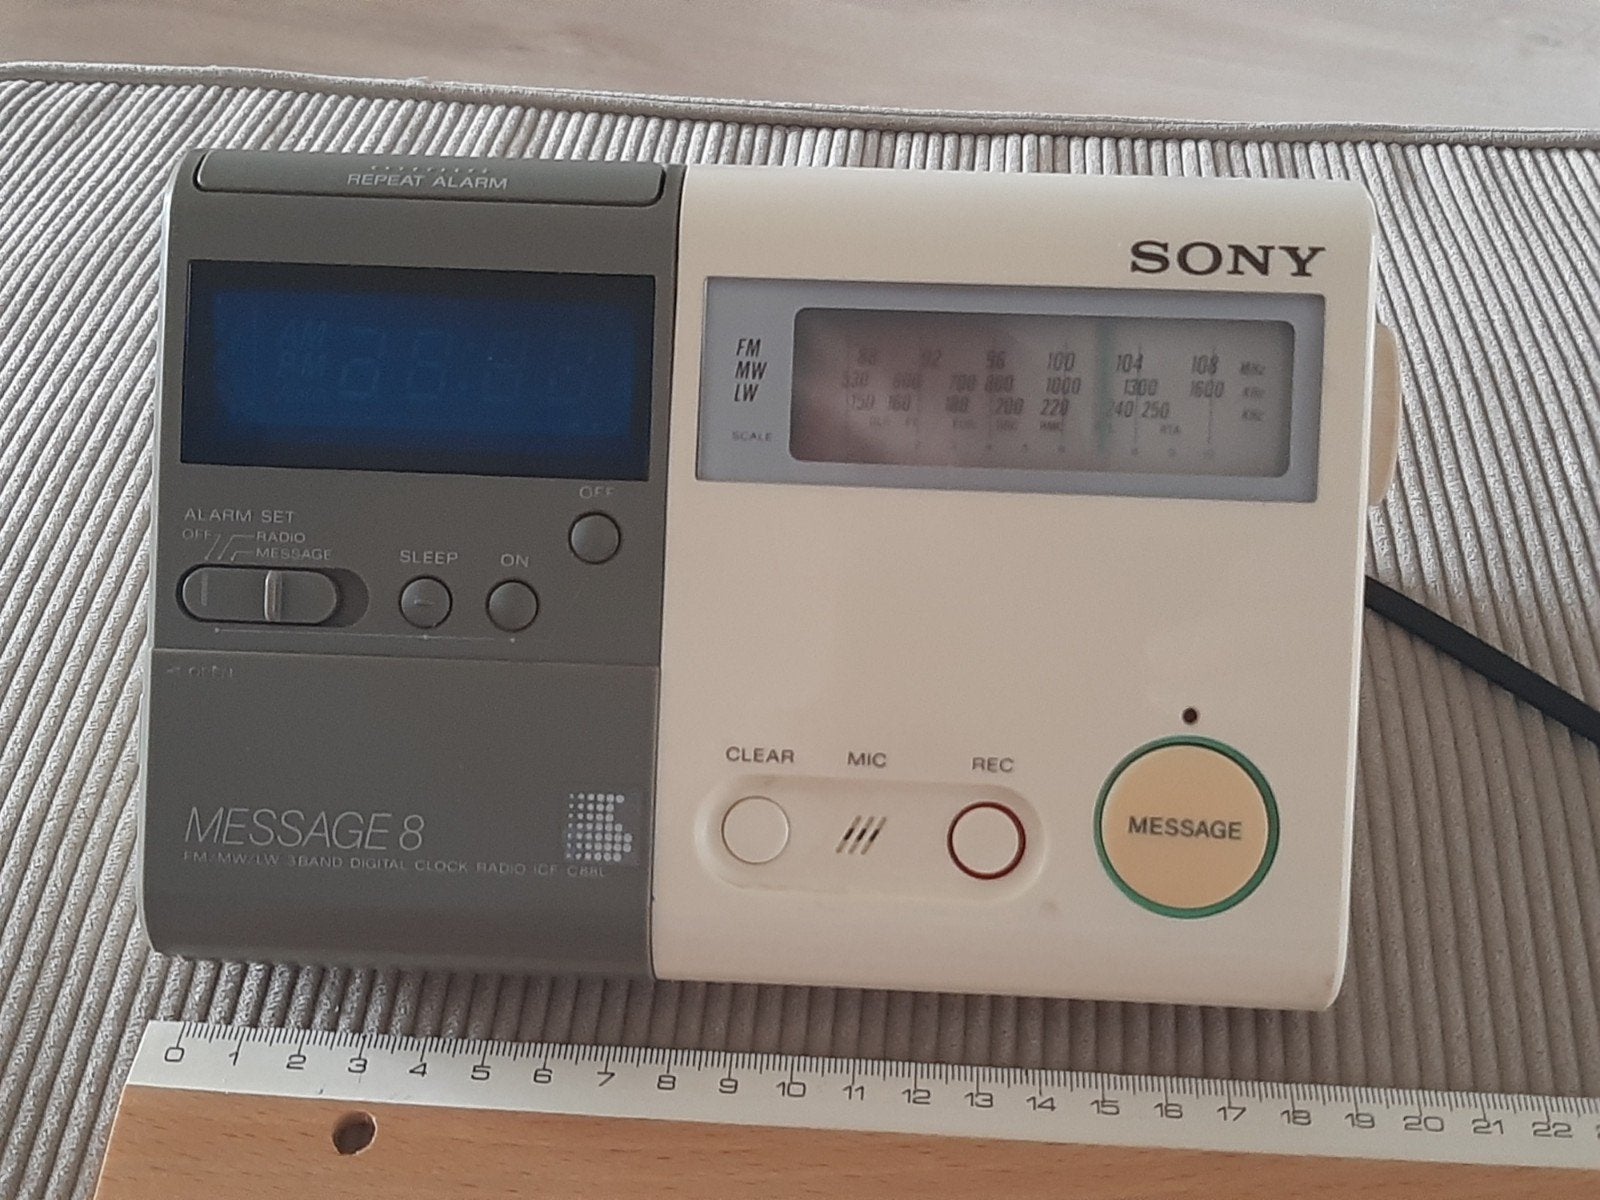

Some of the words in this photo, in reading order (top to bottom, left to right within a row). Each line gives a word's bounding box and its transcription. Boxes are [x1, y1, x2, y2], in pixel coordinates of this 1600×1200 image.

[347, 173, 425, 187] REPEAT
[432, 175, 508, 190] ALARM
[1130, 239, 1326, 277] SONY
[736, 337, 762, 357] FM
[734, 360, 768, 382] MW
[1047, 351, 1076, 372] 100
[1116, 352, 1144, 373] 104
[1191, 353, 1220, 375] 108
[734, 383, 760, 403] LW
[1045, 377, 1082, 395] 1000
[1123, 378, 1160, 397] 1300
[1190, 379, 1225, 398] 1600
[1040, 398, 1070, 417] 220
[1141, 400, 1170, 420] 250
[732, 429, 773, 443] SCALE
[579, 486, 613, 499] OFF
[184, 507, 252, 523] ALARM
[261, 509, 294, 524] SET
[182, 528, 213, 540] OFF
[256, 531, 306, 543] RADIO
[256, 547, 332, 561] MESSAGE
[400, 549, 458, 566] SLEEP
[501, 552, 529, 569] ON
[726, 747, 795, 764] CLEAR
[847, 752, 887, 769] MIC
[972, 756, 1014, 774] REC
[185, 806, 393, 851] MESSAGE
[399, 814, 426, 852] 8
[1128, 815, 1243, 841] MESSAGE
[350, 857, 405, 870] DIGITAL
[415, 859, 468, 873] CLOCK
[476, 861, 526, 875] RADIO
[164, 1046, 184, 1063] 0
[286, 1054, 307, 1071] 2
[347, 1057, 368, 1074] 3
[409, 1061, 428, 1078] 4
[471, 1064, 491, 1081] 5
[533, 1067, 553, 1084] 6
[597, 1071, 616, 1087] 7
[657, 1075, 676, 1091] 8
[719, 1078, 739, 1094] 9
[776, 1081, 807, 1098] 10
[842, 1085, 866, 1101] 11
[902, 1088, 931, 1105] 12
[964, 1092, 994, 1109] 13
[1026, 1096, 1057, 1112] 14
[1090, 1099, 1120, 1116] 15
[1154, 1102, 1184, 1119] 16
[1217, 1106, 1247, 1122] 17
[1280, 1109, 1312, 1126] 18
[1344, 1112, 1376, 1130] 19
[1403, 1115, 1445, 1132] 20
[1472, 1118, 1504, 1135] 21
[1531, 1121, 1574, 1138] 22
